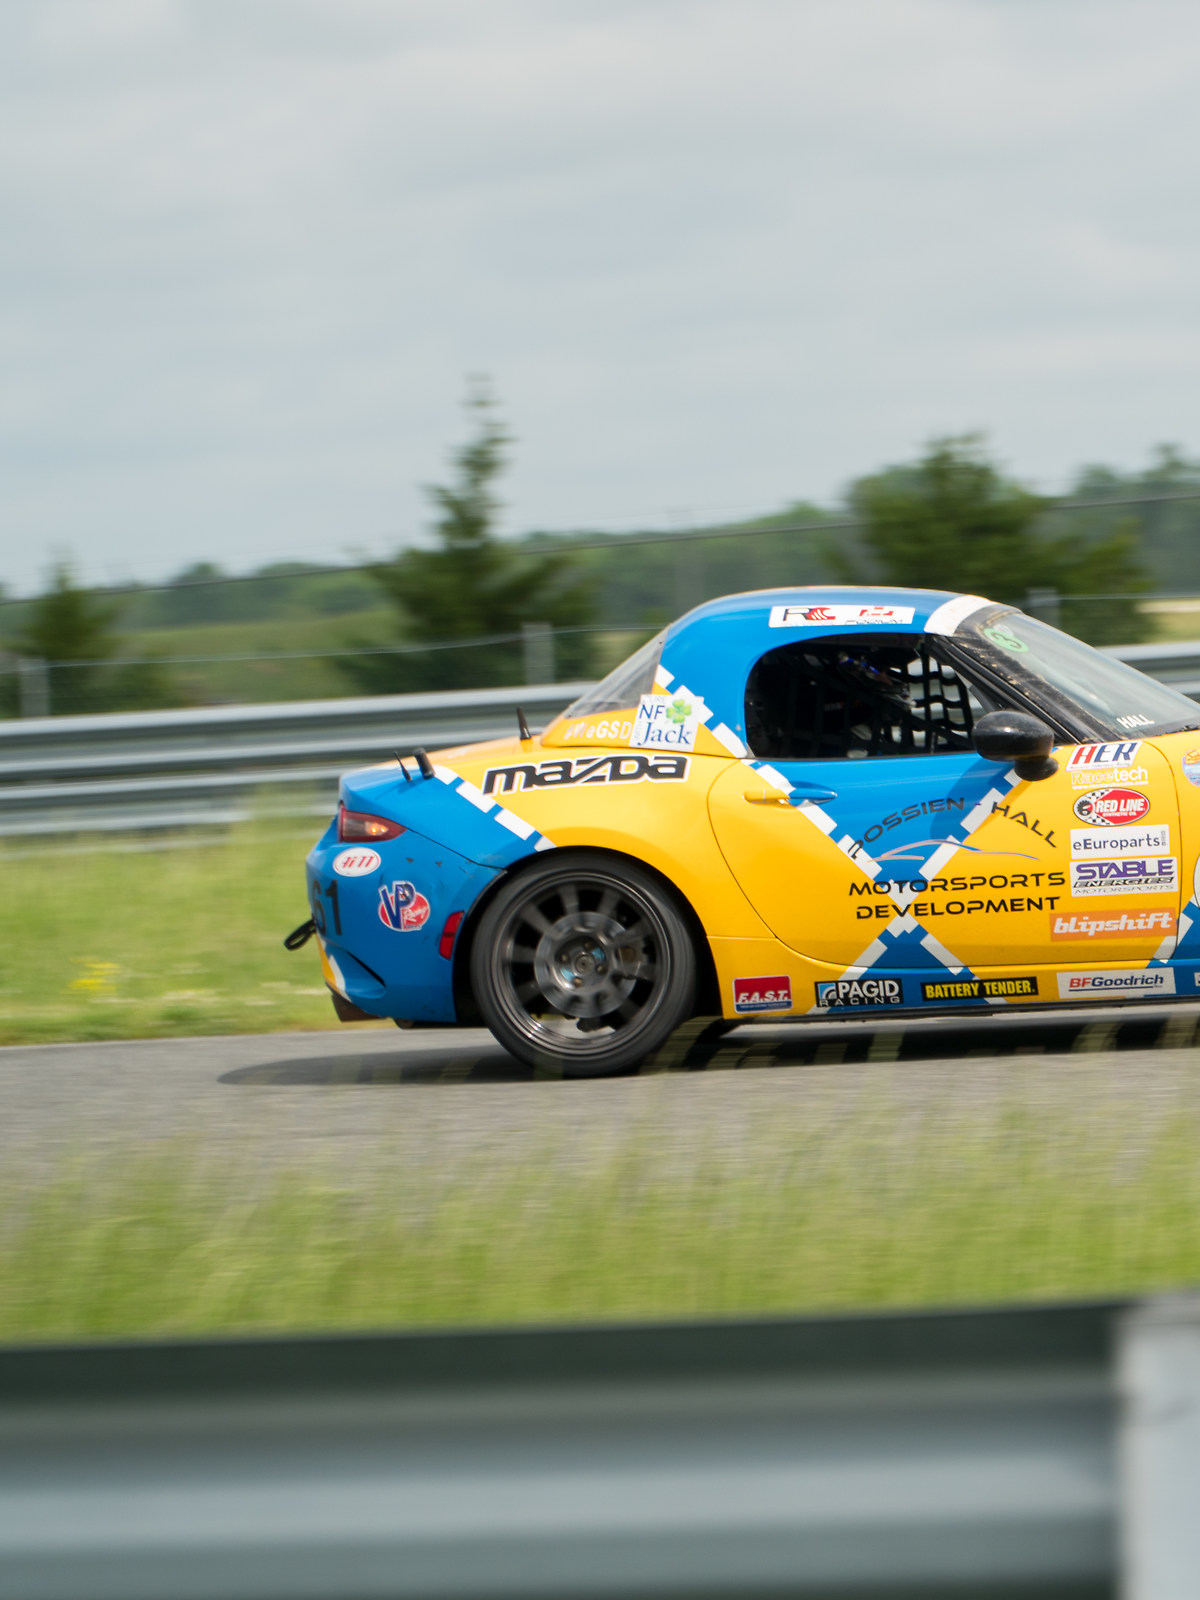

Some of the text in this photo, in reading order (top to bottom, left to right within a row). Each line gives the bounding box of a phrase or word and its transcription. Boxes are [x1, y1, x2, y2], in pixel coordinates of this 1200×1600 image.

[639, 704, 665, 719] NF
[1117, 714, 1155, 729] HALL
[637, 722, 693, 746] Jack
[1071, 766, 1149, 785] Racetech
[1096, 799, 1145, 813] RED LINE
[991, 802, 1057, 848] HALL
[1075, 859, 1174, 880] STABLE
[849, 872, 1065, 896] MOTORSPORTS
[1073, 876, 1174, 888] ENERGIES
[1074, 884, 1174, 895] MOTORSPORTS
[378, 881, 416, 931] VP
[856, 896, 1060, 919] DEVELOPMENT
[1053, 912, 1173, 936] blipshift
[838, 981, 900, 998] PAGID
[925, 982, 980, 998] BATTERY
[1068, 974, 1164, 990] BFGoodrich
[819, 997, 900, 1007] RACING
